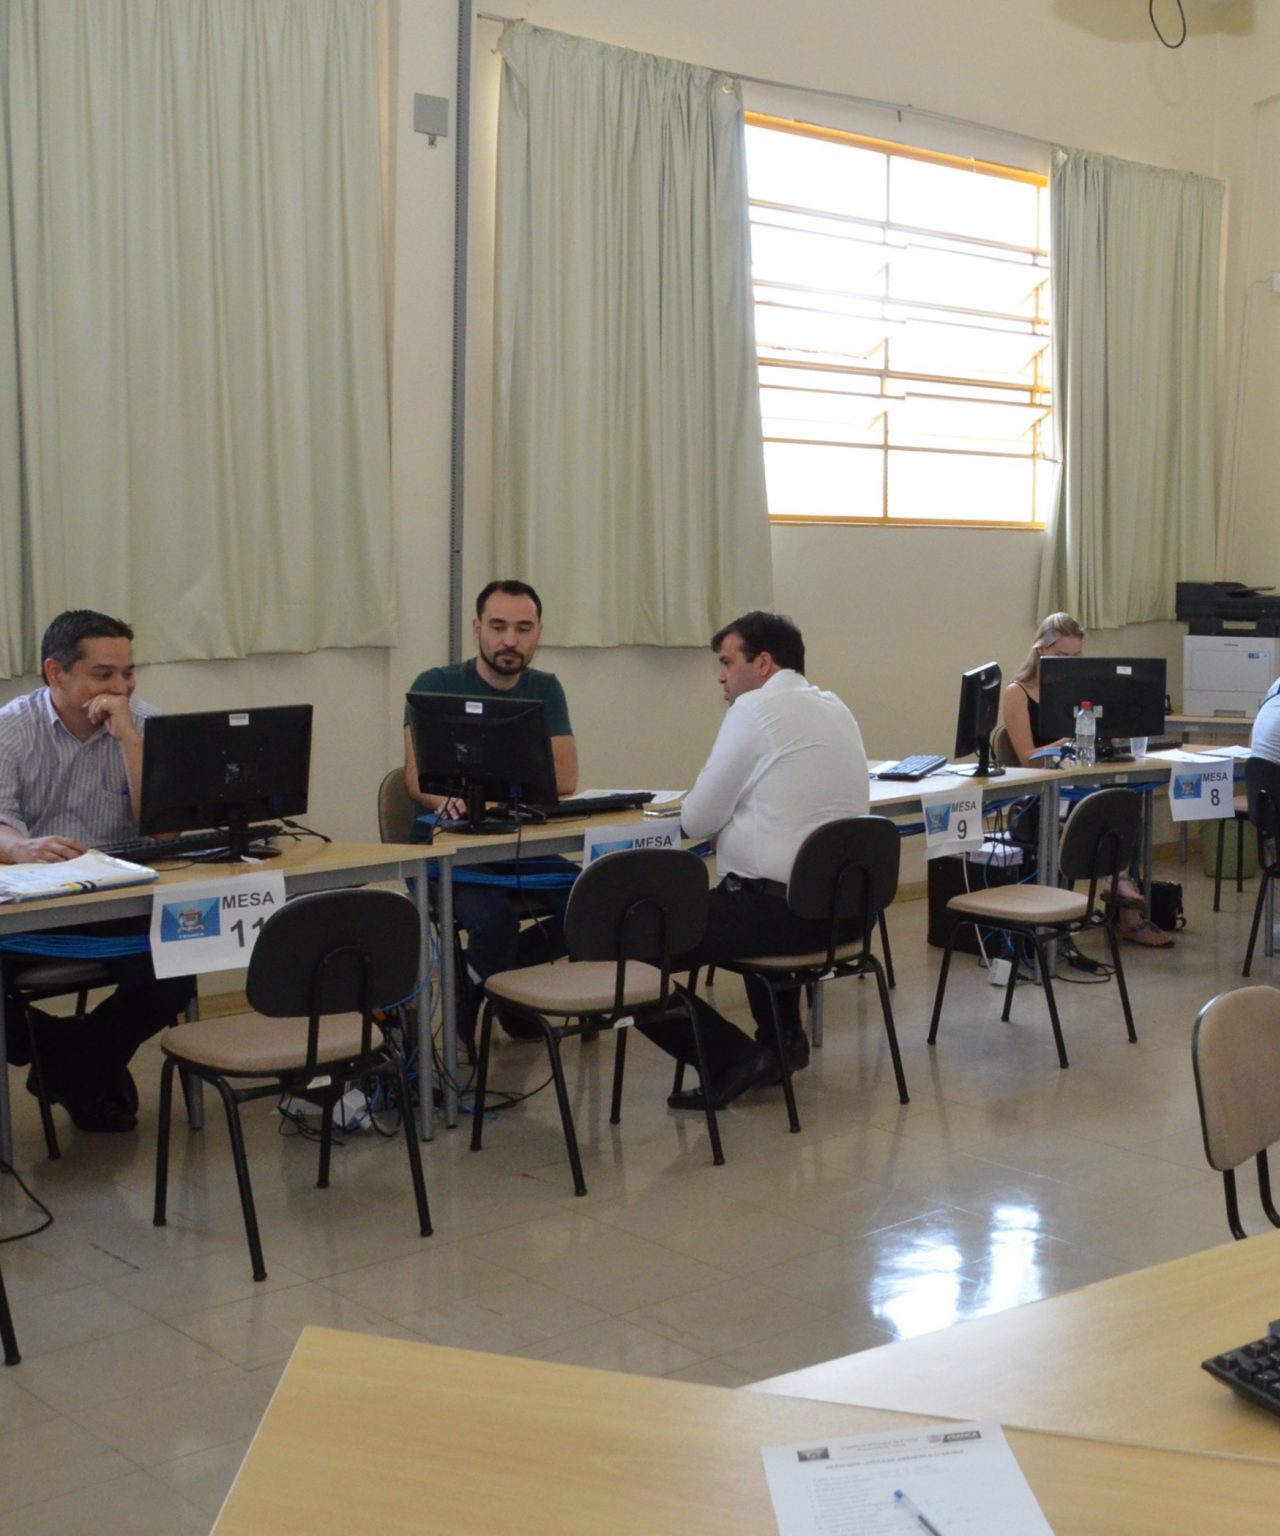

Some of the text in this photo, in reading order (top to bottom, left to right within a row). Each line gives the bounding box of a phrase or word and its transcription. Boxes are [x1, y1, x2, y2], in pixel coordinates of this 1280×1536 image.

[1202, 771, 1228, 782] MESA
[952, 801, 977, 812] MESA
[1211, 788, 1220, 807] 8
[957, 819, 967, 840] 9
[222, 891, 275, 910] MESA
